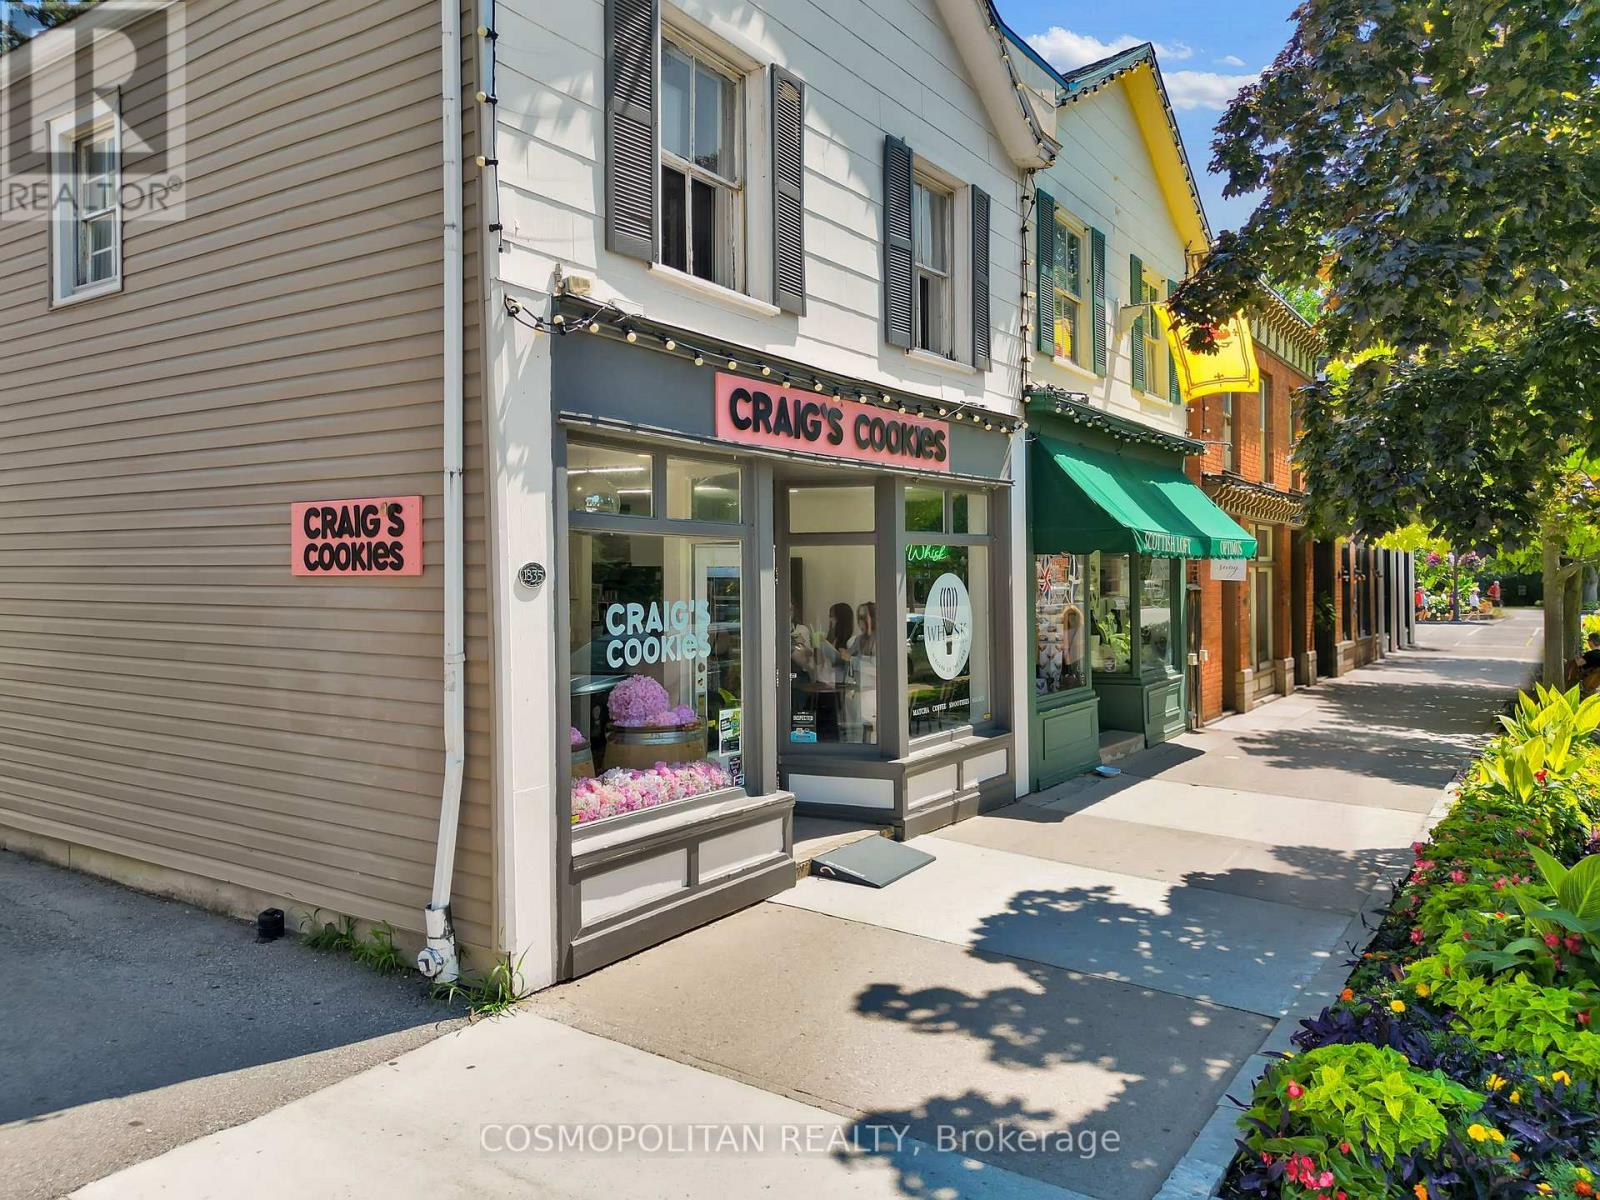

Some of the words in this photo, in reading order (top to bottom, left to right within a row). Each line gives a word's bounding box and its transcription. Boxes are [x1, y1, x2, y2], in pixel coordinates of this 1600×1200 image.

[729, 387, 844, 446] CRAIG'S
[1144, 531, 1175, 552] SCOTTISH
[905, 544, 949, 562] Whisk
[605, 599, 711, 636] CRAIG'S
[912, 707, 930, 717] MATCHA
[932, 703, 947, 712] COFFEE
